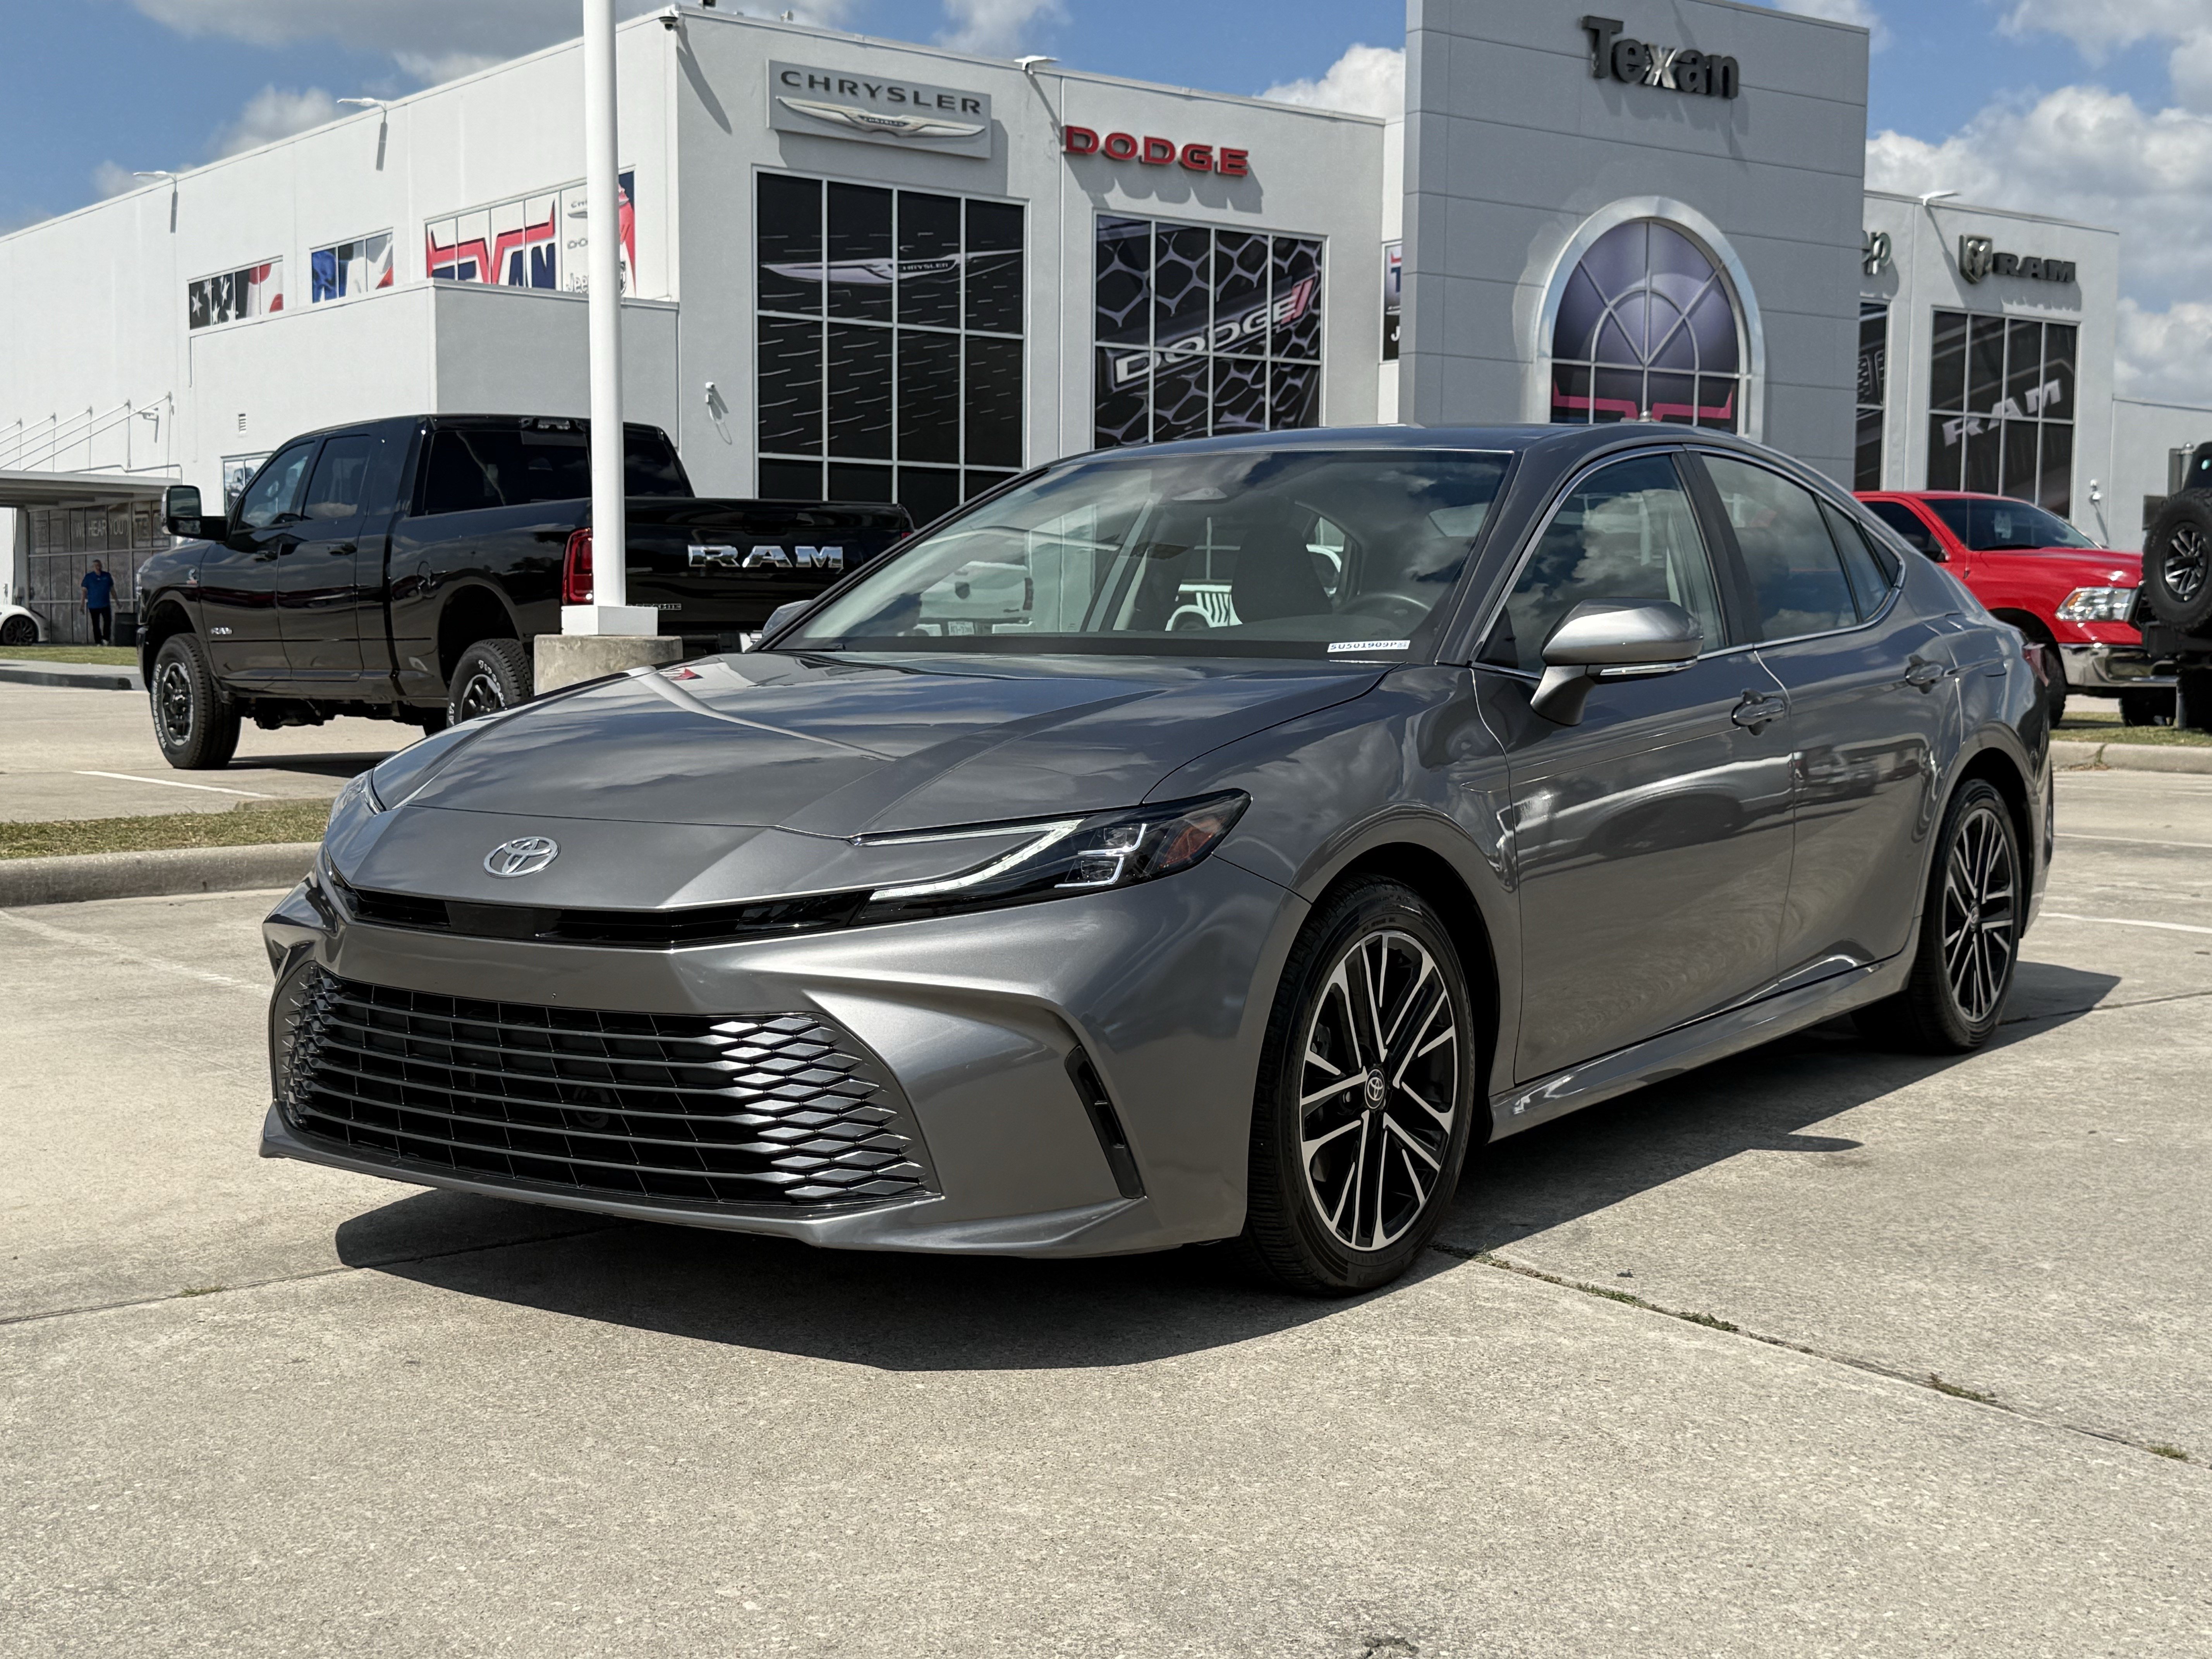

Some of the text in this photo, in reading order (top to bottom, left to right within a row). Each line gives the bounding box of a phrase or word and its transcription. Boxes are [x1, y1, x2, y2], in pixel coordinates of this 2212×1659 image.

[1581, 15, 1739, 99] Texan
[780, 70, 981, 113] CHRYSLER
[1064, 125, 1249, 175] DODGE
[565, 272, 589, 294] Jee
[1992, 252, 2076, 283] RAM
[1115, 295, 1297, 383] DODGE
[1942, 379, 2061, 447] RAM
[688, 544, 843, 568] RAM
